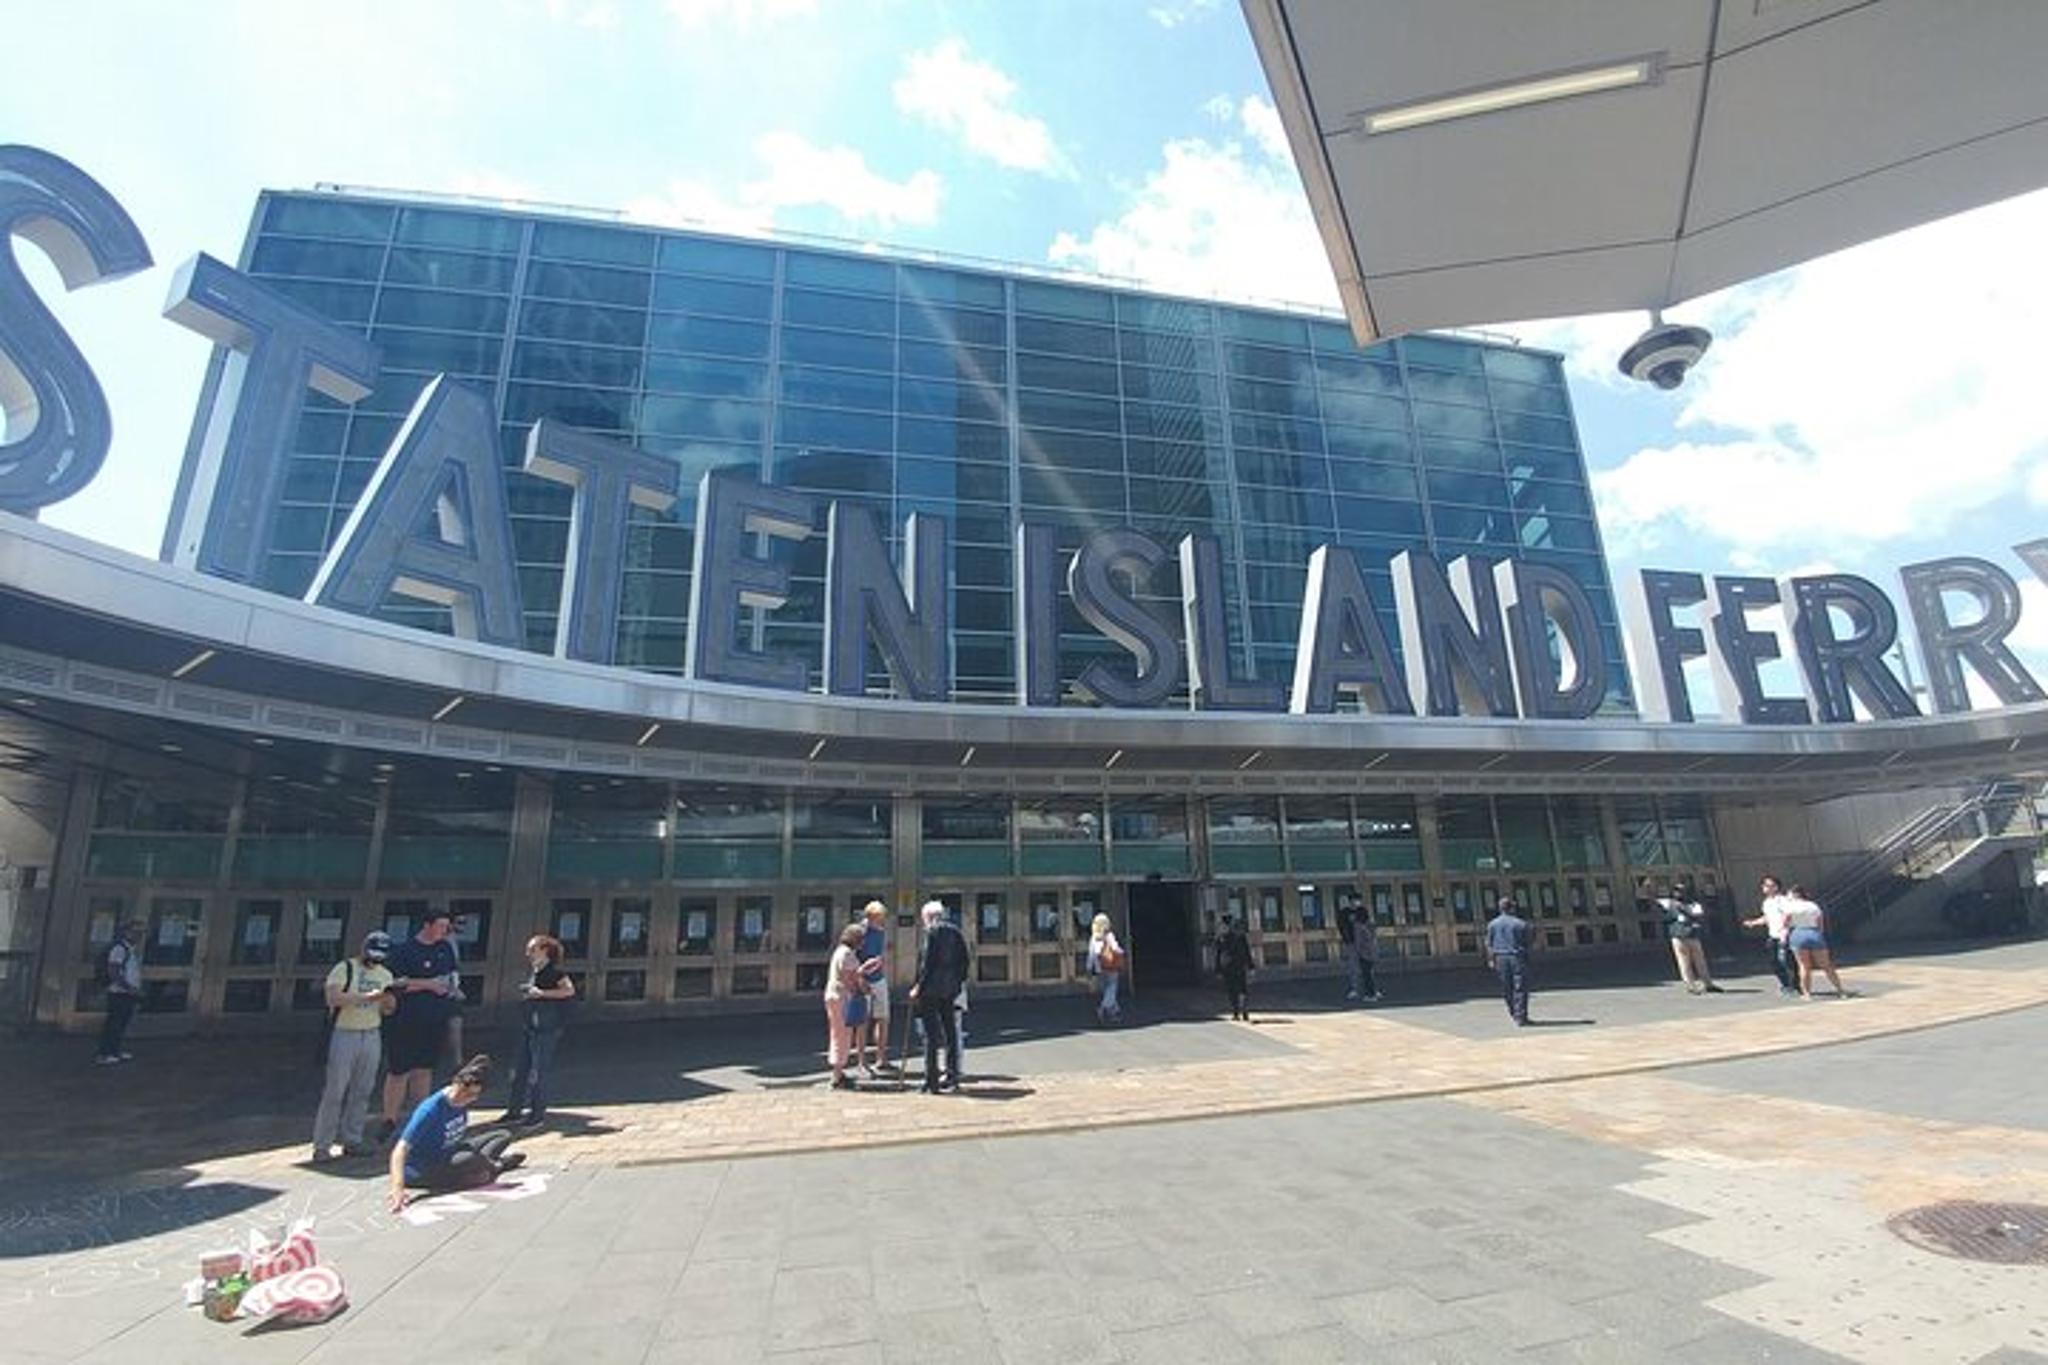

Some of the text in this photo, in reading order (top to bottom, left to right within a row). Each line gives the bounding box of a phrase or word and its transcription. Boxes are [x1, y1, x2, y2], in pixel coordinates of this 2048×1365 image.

[0, 144, 2048, 724] STATEN ISLAND FERR
